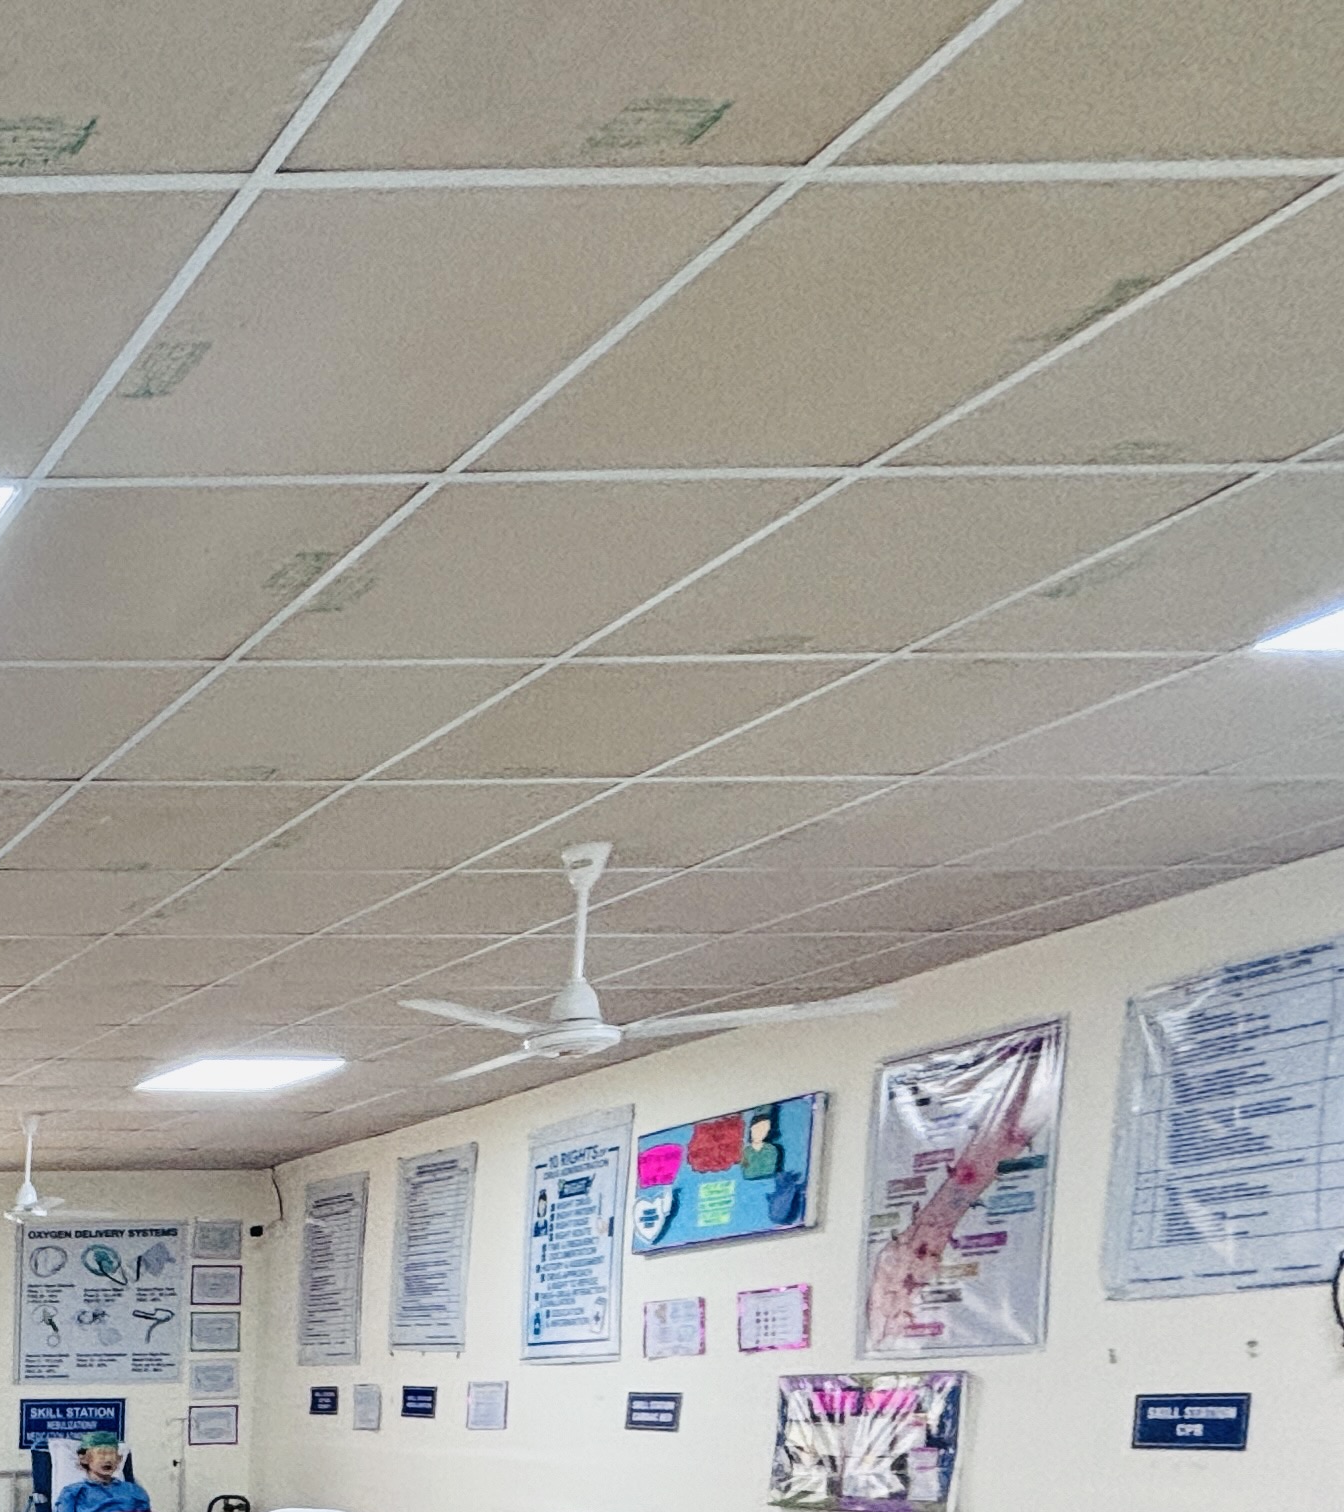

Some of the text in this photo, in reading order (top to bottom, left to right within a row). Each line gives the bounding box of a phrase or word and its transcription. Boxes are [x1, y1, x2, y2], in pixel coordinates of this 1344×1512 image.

[28, 1227, 178, 1239] OXYGEN DELIVERY SYSTEMS
[30, 1407, 115, 1419] SKILL STATION
[1175, 1423, 1204, 1437] CPR
